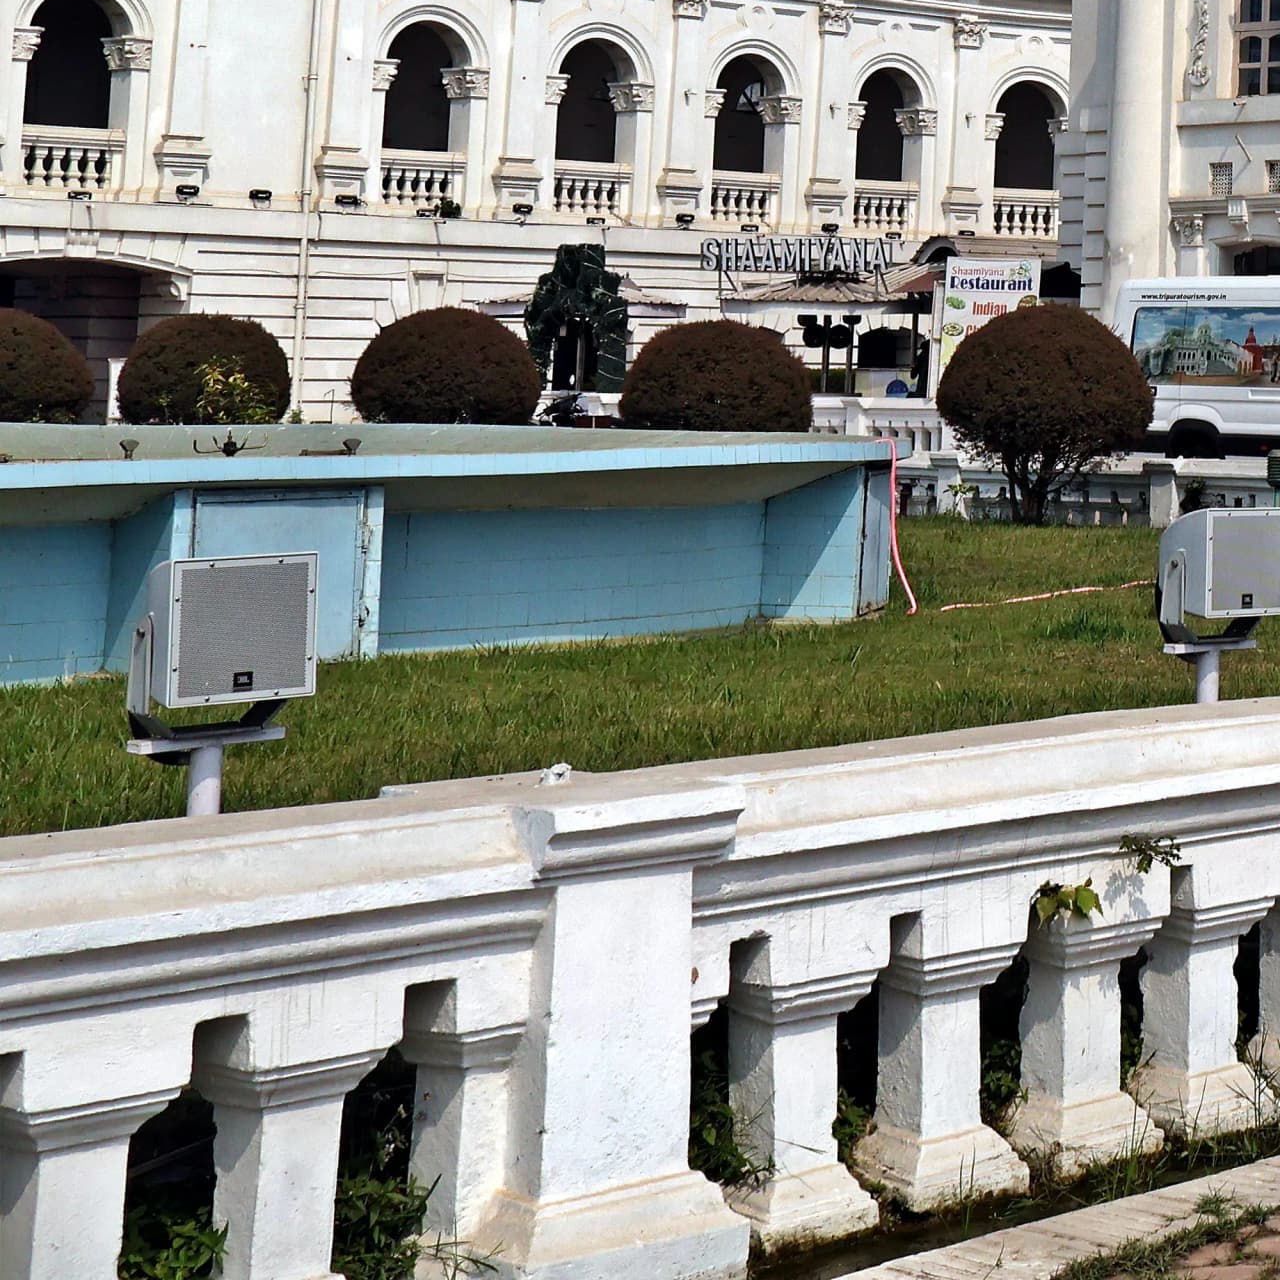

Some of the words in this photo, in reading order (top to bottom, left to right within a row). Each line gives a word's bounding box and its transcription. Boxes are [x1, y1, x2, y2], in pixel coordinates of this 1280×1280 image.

[702, 237, 889, 271] SHAAMIYANA
[951, 265, 1005, 278] Shaamiyana
[949, 275, 1033, 291] Restaurant
[1141, 292, 1226, 301] www.tripuratourism.gov.in
[972, 301, 1007, 316] Indian
